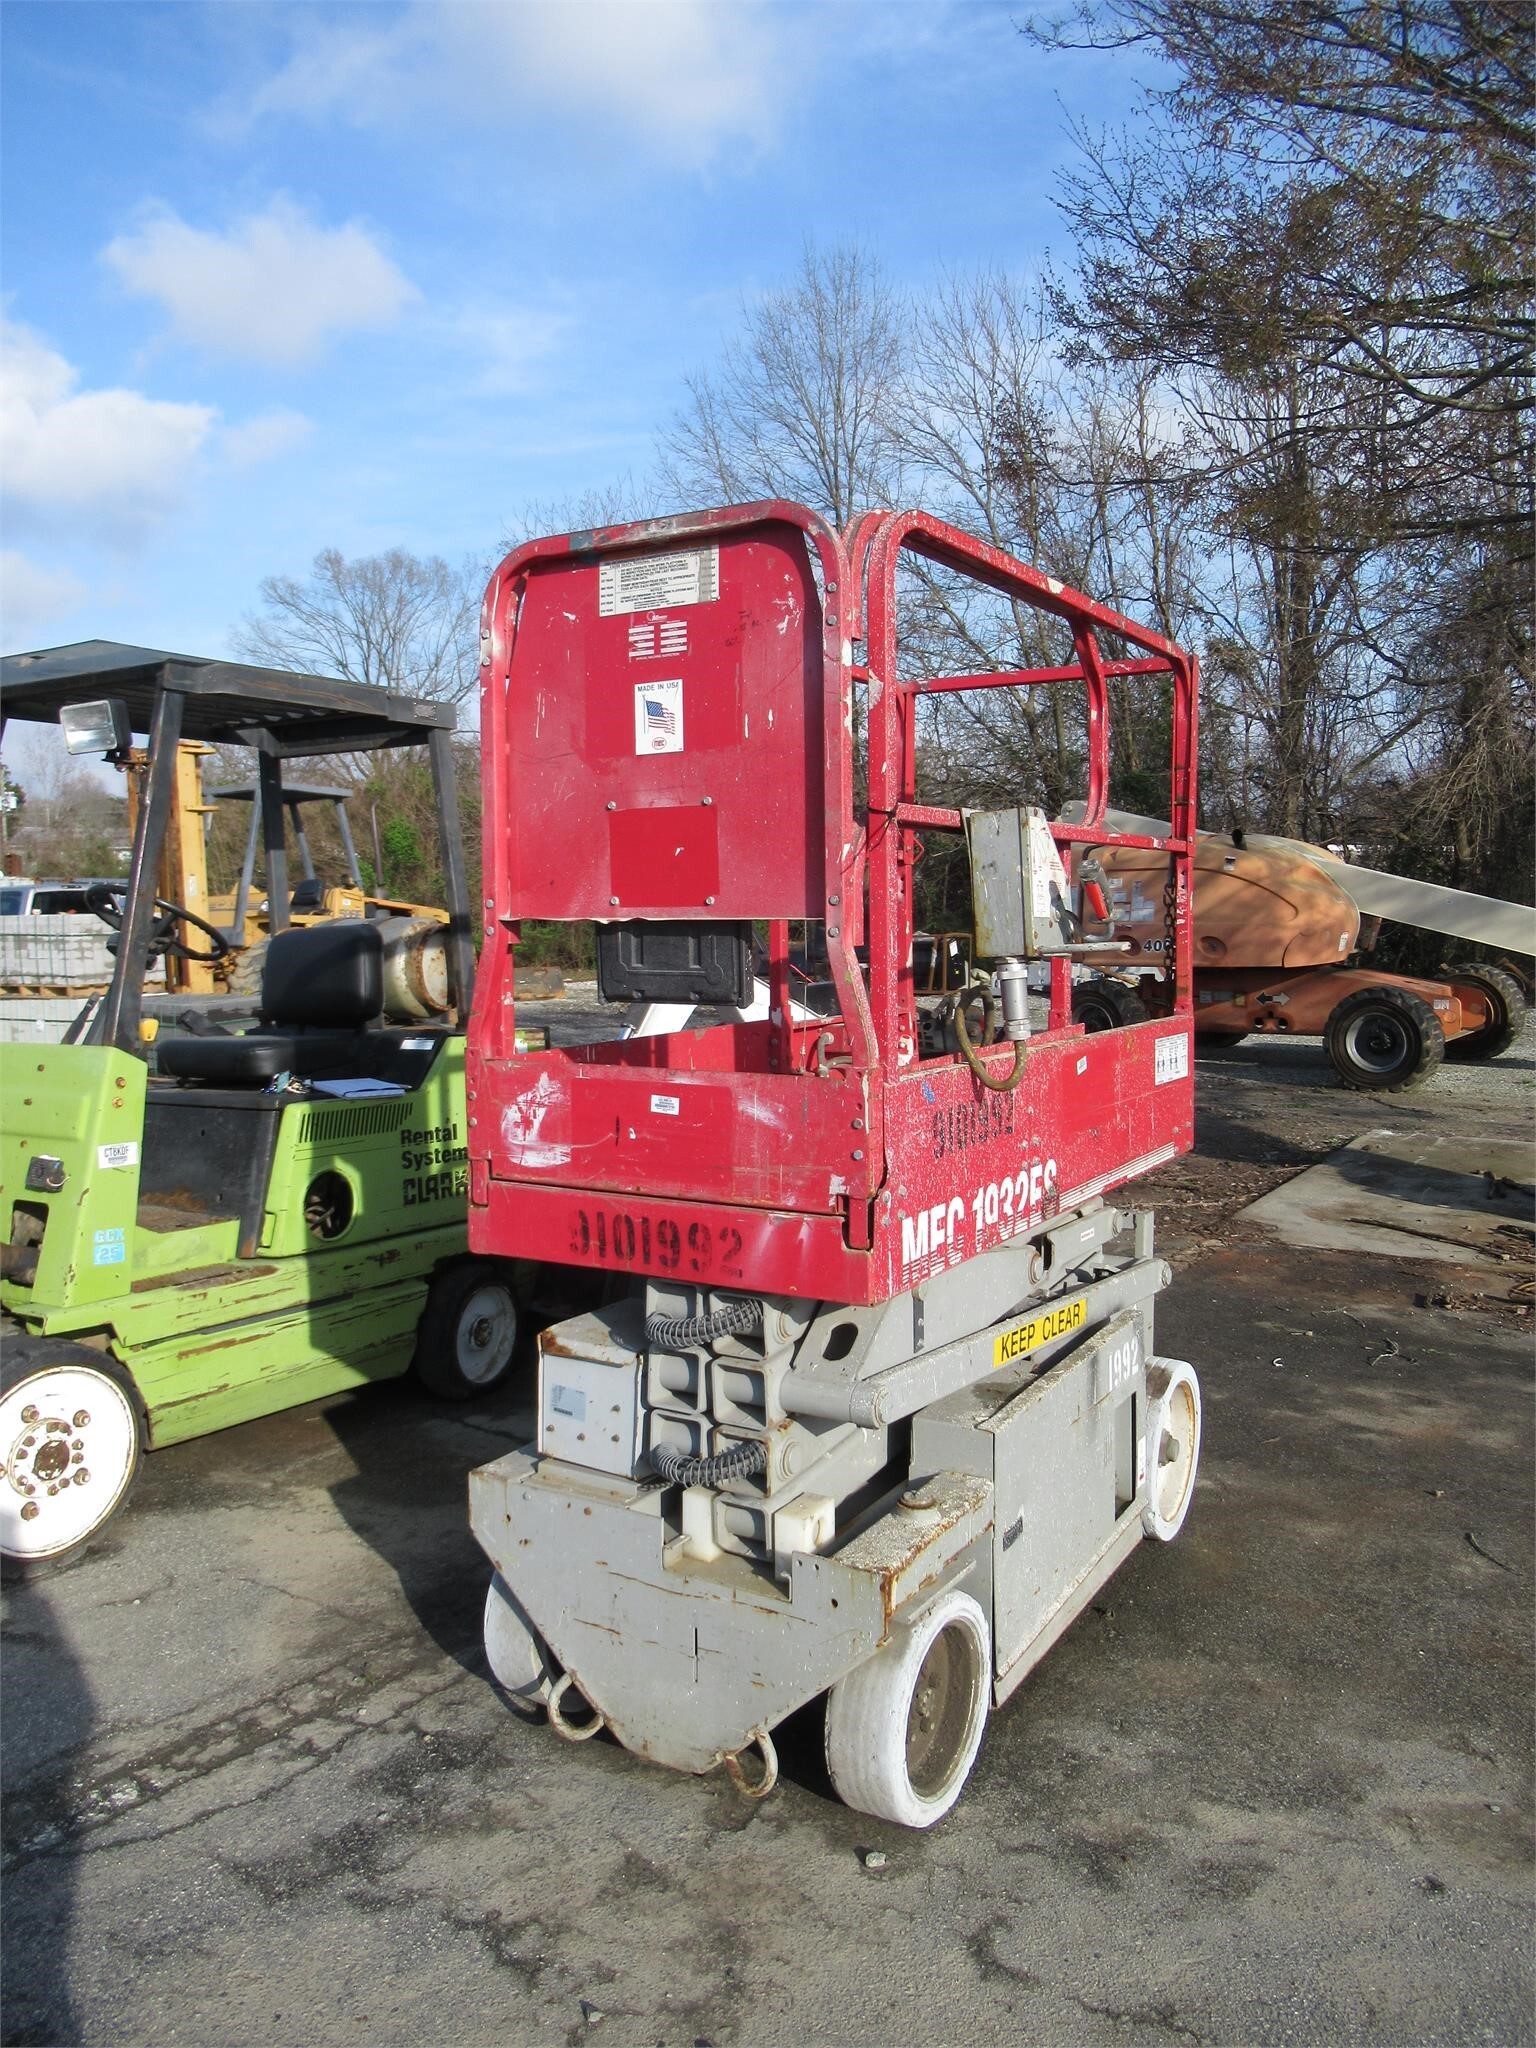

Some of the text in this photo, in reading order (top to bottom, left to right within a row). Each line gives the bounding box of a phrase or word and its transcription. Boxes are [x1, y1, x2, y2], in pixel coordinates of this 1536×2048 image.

[637, 681, 680, 693] MADE IN USA
[400, 1123, 458, 1147] Rental
[902, 1196, 965, 1288] MEC
[1000, 1302, 1081, 1362] KEEP CLEAR
[1108, 1336, 1139, 1392] 1992
